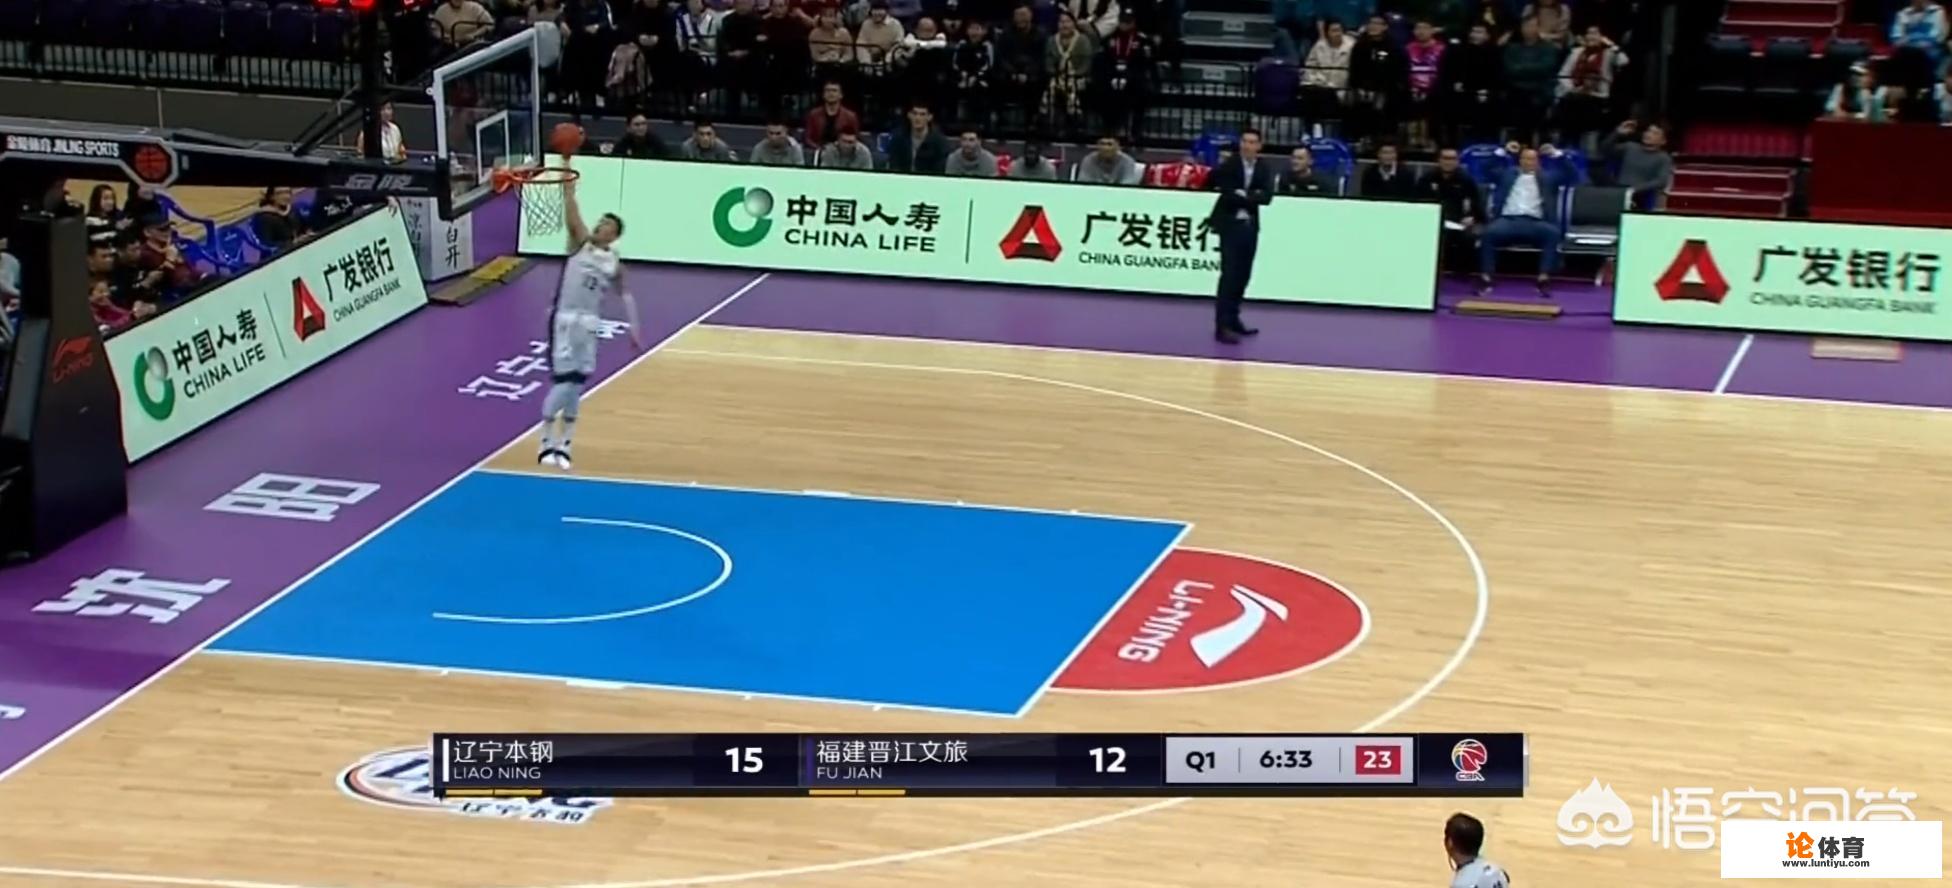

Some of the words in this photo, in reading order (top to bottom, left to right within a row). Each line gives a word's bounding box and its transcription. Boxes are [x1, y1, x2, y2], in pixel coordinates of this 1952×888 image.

[84, 140, 119, 157] SPORTS
[787, 194, 941, 233] 中国人寿
[784, 228, 868, 249] CHINA
[878, 233, 936, 252] LIFE
[322, 237, 395, 302] 广发银行
[1078, 251, 1121, 266] CHINA
[1123, 254, 1189, 270] GUANGFA
[1191, 258, 1221, 271] BAN
[1752, 245, 1942, 293] 广发银行
[1750, 291, 1802, 306] CHINA
[172, 309, 258, 375] 中国人寿
[183, 363, 232, 398] CHINA
[232, 343, 266, 373] LIFE
